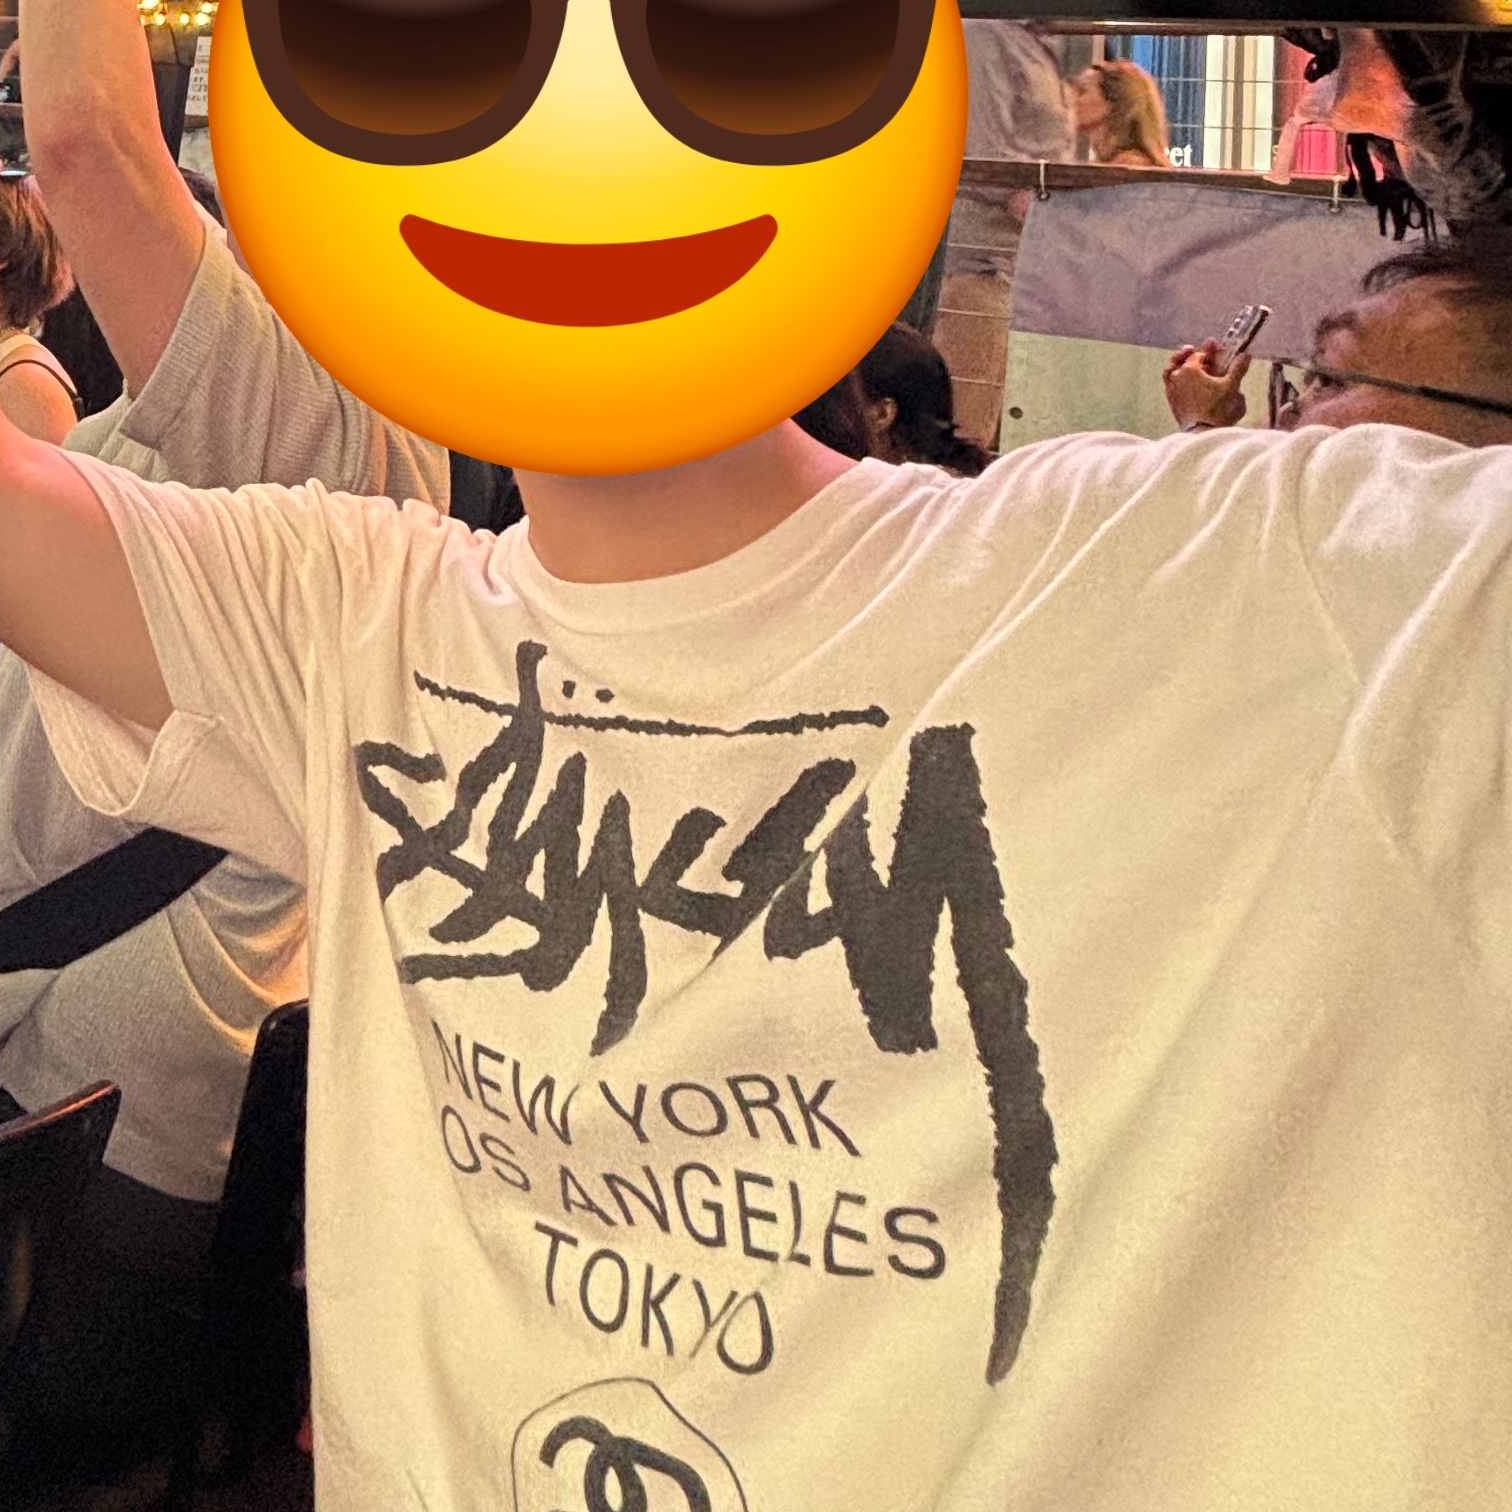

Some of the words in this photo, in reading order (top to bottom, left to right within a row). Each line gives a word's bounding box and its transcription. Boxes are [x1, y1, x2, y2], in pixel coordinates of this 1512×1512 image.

[1164, 144, 1193, 168] et
[432, 1020, 579, 1146] NEW
[600, 1072, 861, 1157] YORK
[442, 1105, 531, 1191] OS
[559, 1161, 946, 1280] ANGELES
[534, 1221, 775, 1375] TOKYO
